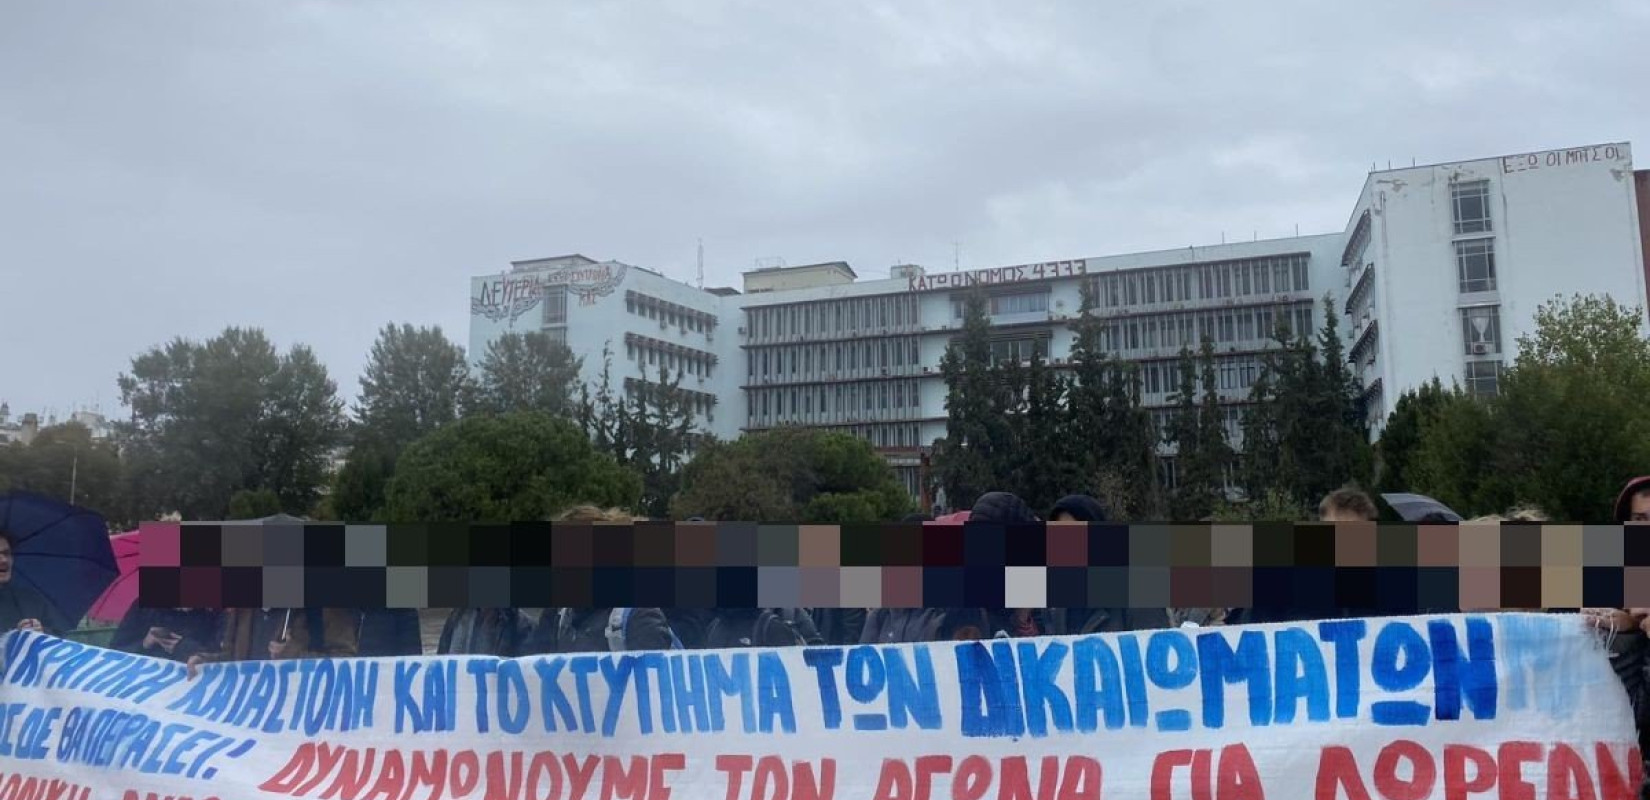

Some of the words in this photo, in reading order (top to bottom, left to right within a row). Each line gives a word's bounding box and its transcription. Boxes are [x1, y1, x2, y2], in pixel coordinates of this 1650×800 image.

[965, 264, 1029, 287] ΝΟΜΟΣ
[394, 660, 458, 734] ΚΑΙ
[467, 658, 530, 737] ΤΟ
[534, 652, 797, 737] ΧΤΥΠΗΜΑ
[803, 645, 942, 731] ΤΩΝ
[954, 617, 1498, 738] ΔΙΚΑΙΩΜΑΤΩΝ
[1150, 742, 1266, 800] ΓΙΑ
